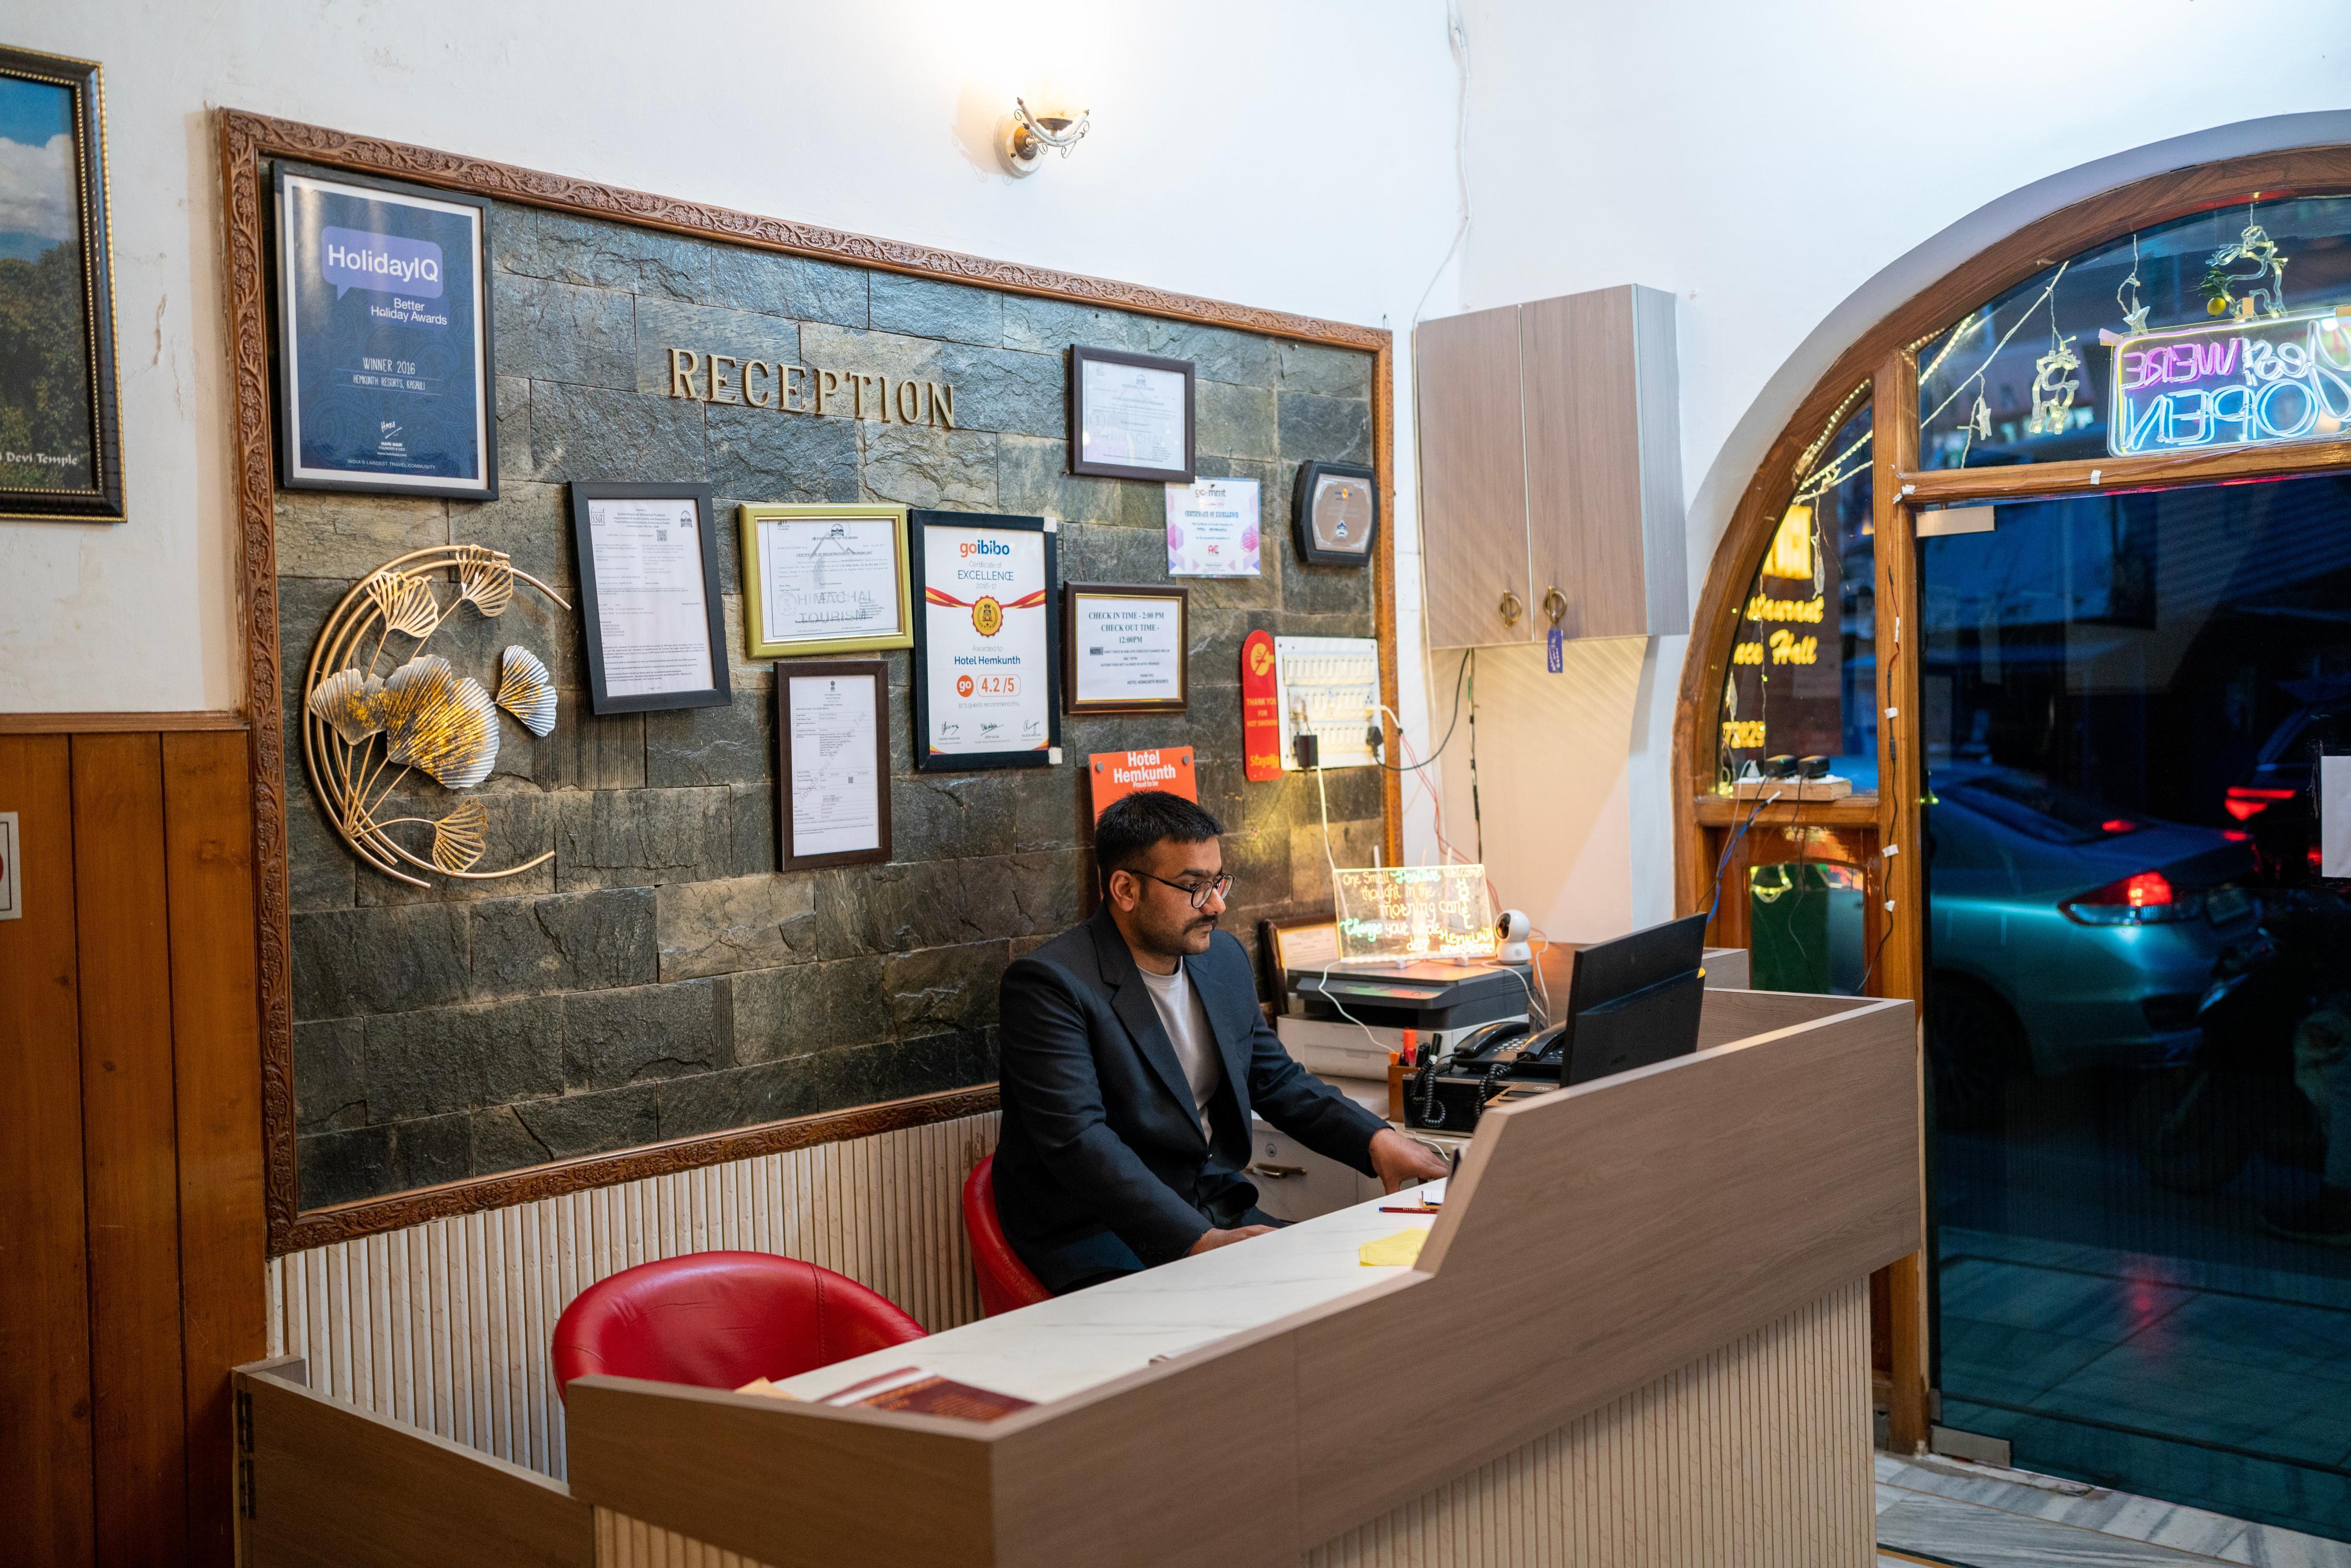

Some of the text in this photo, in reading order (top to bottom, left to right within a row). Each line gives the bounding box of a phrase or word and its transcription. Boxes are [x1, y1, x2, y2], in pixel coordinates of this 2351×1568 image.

[328, 243, 438, 283] HolidayIQ
[394, 297, 425, 312] Better
[371, 305, 447, 326] Holiday Awards
[363, 357, 415, 375] WINNER 2016
[353, 375, 425, 391] HEMKUNTH RESORTS, KASAULI
[668, 348, 956, 429] RECEPTION
[6, 451, 78, 467] Devi Temple
[960, 539, 1009, 557] goibibo
[955, 655, 1020, 665] Hotel Hemkunth
[959, 681, 972, 692] go
[1127, 750, 1160, 766] Hotel
[1113, 764, 1176, 784] Hemkunth
